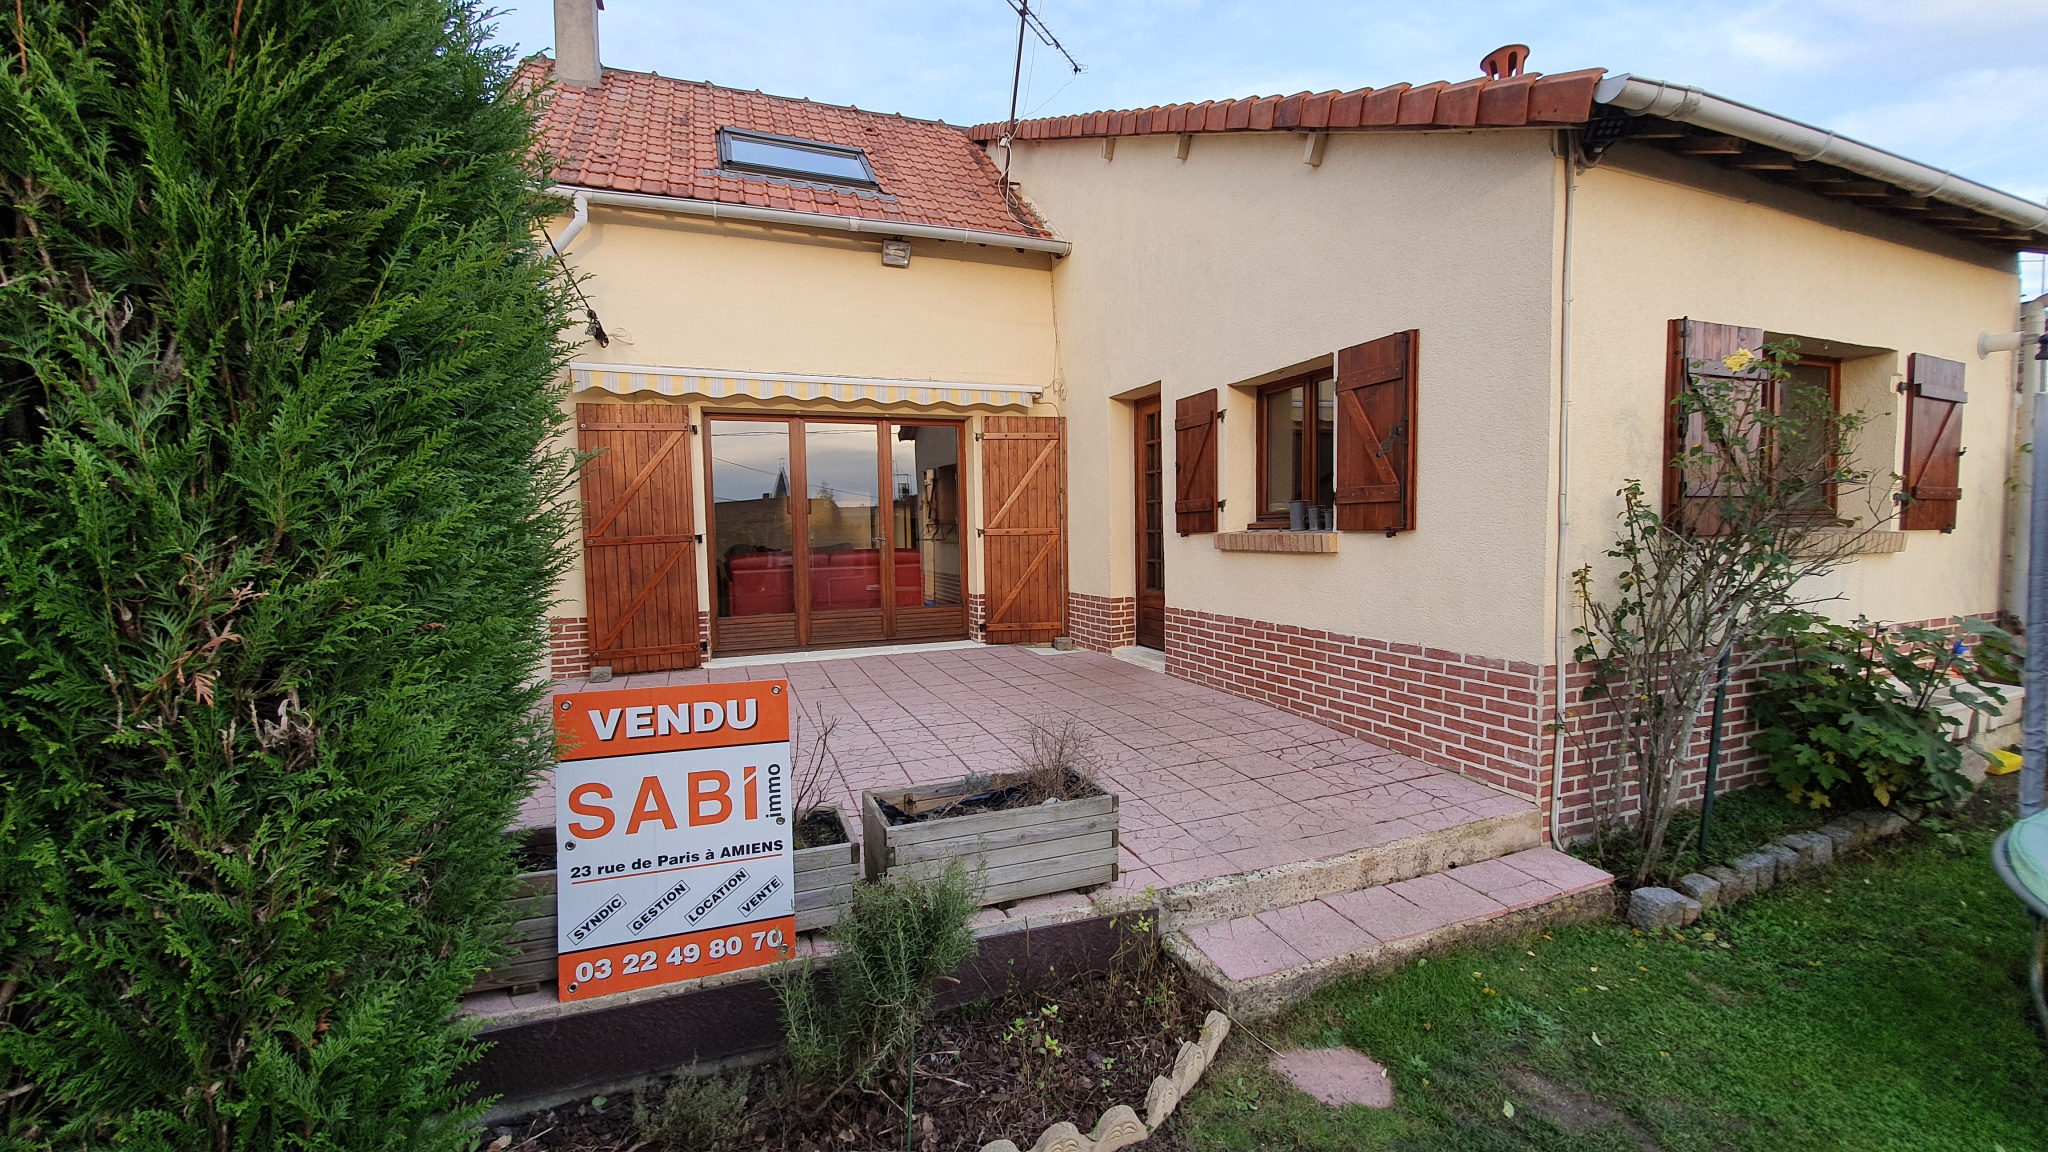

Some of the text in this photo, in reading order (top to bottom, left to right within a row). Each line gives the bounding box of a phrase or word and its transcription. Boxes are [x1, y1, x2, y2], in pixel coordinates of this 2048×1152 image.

[588, 699, 758, 741] VENDU
[766, 763, 782, 818] immo
[570, 840, 784, 879] 23 rue de Paris à AMIENS
[632, 883, 687, 931] GESTION
[688, 871, 747, 922] LOCATION
[742, 878, 781, 914] VENTE
[573, 898, 623, 940] SYNDIC
[575, 929, 783, 983] 03 22 49 80 70
